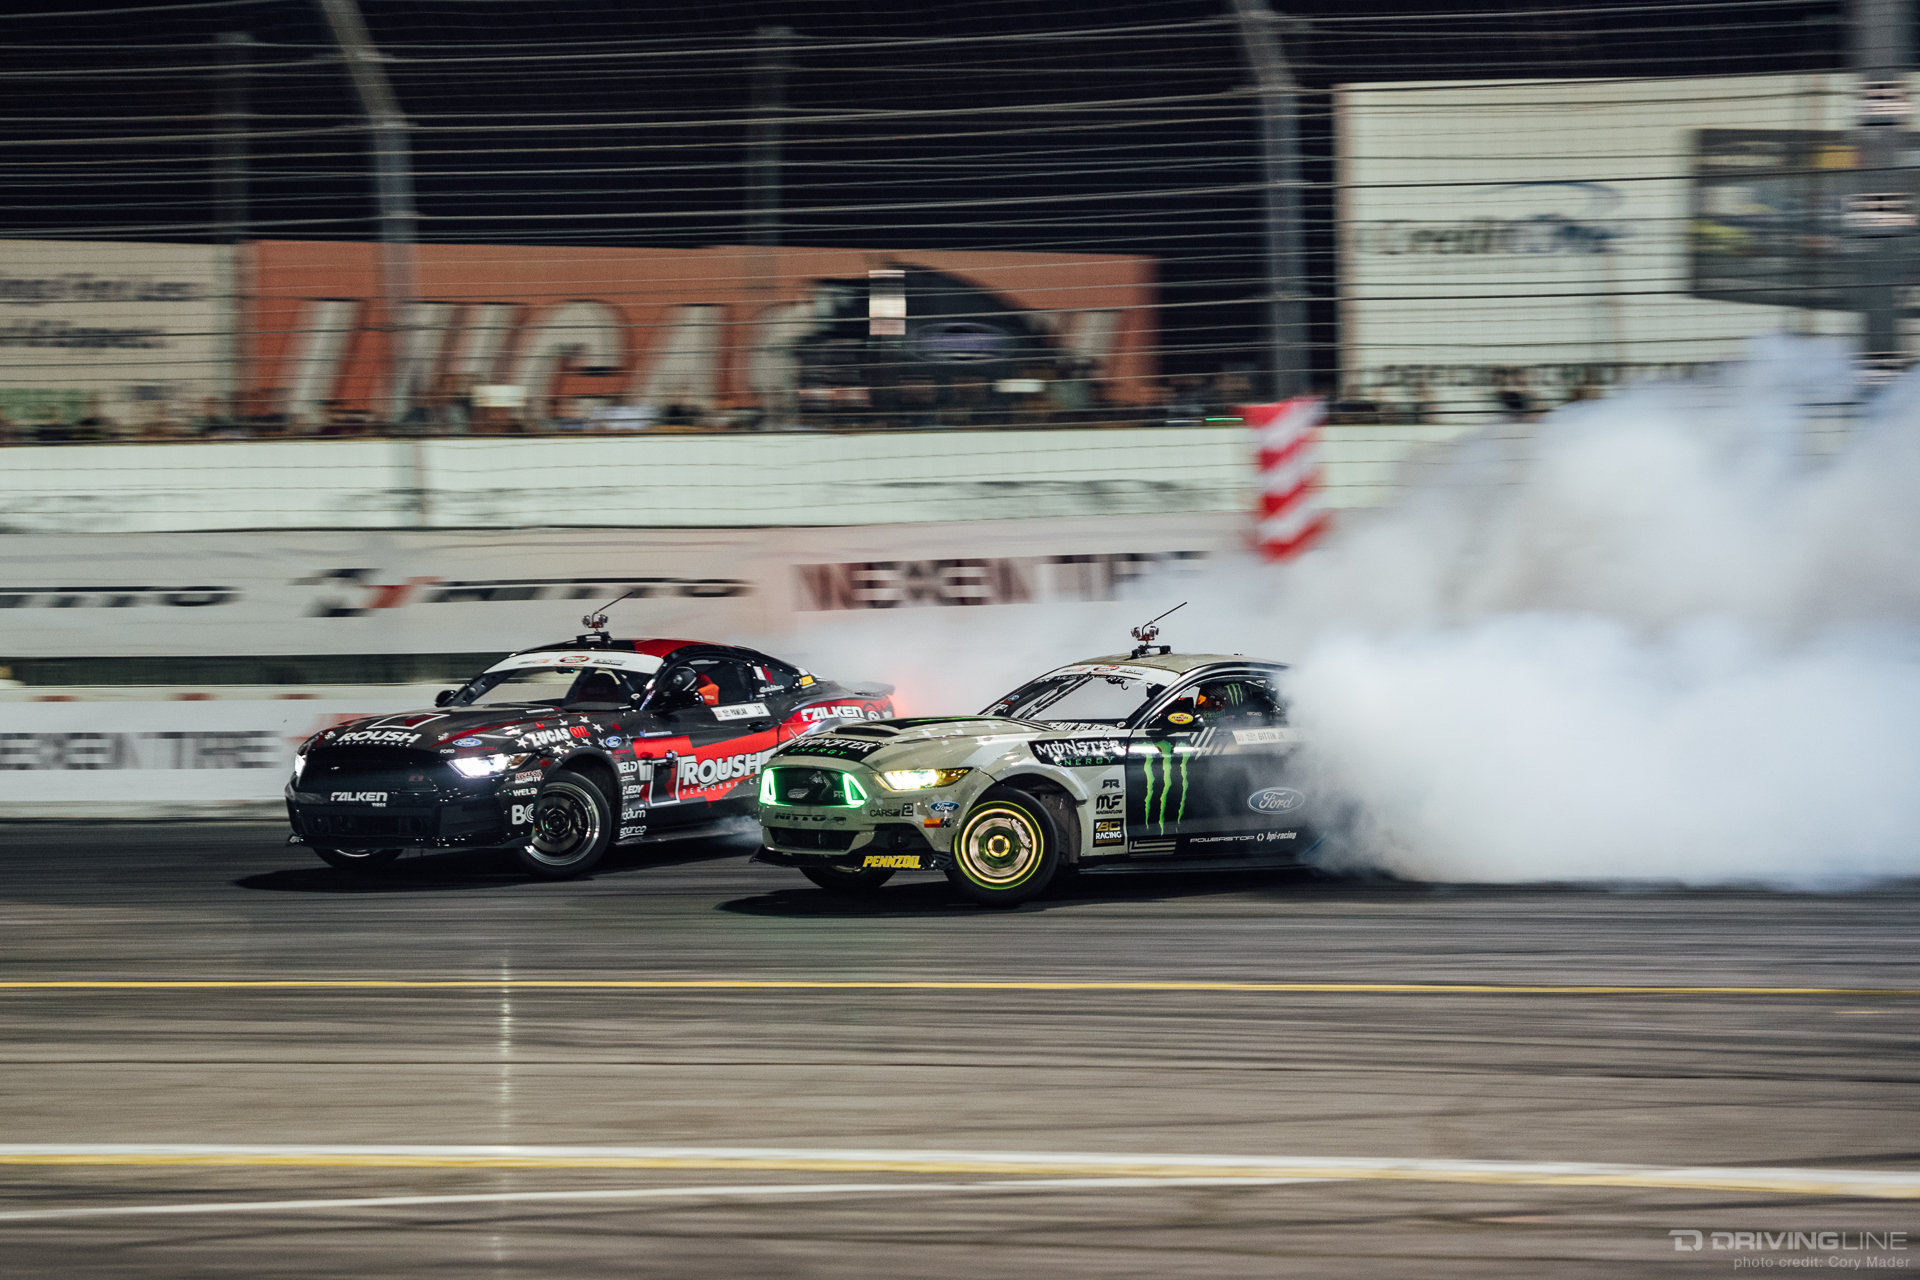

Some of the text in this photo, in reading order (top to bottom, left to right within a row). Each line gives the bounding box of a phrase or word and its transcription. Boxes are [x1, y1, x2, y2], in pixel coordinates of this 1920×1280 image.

[801, 706, 865, 722] FALKEN
[336, 730, 422, 743] ROUSH
[531, 726, 591, 747] LUCAS OIL
[790, 747, 847, 756] ENERGY
[682, 751, 762, 786] ROUSH
[330, 791, 388, 801] FALKEN
[1258, 791, 1295, 809] Ford
[1095, 831, 1122, 840] RACING
[862, 855, 922, 869] PENNZOIL
